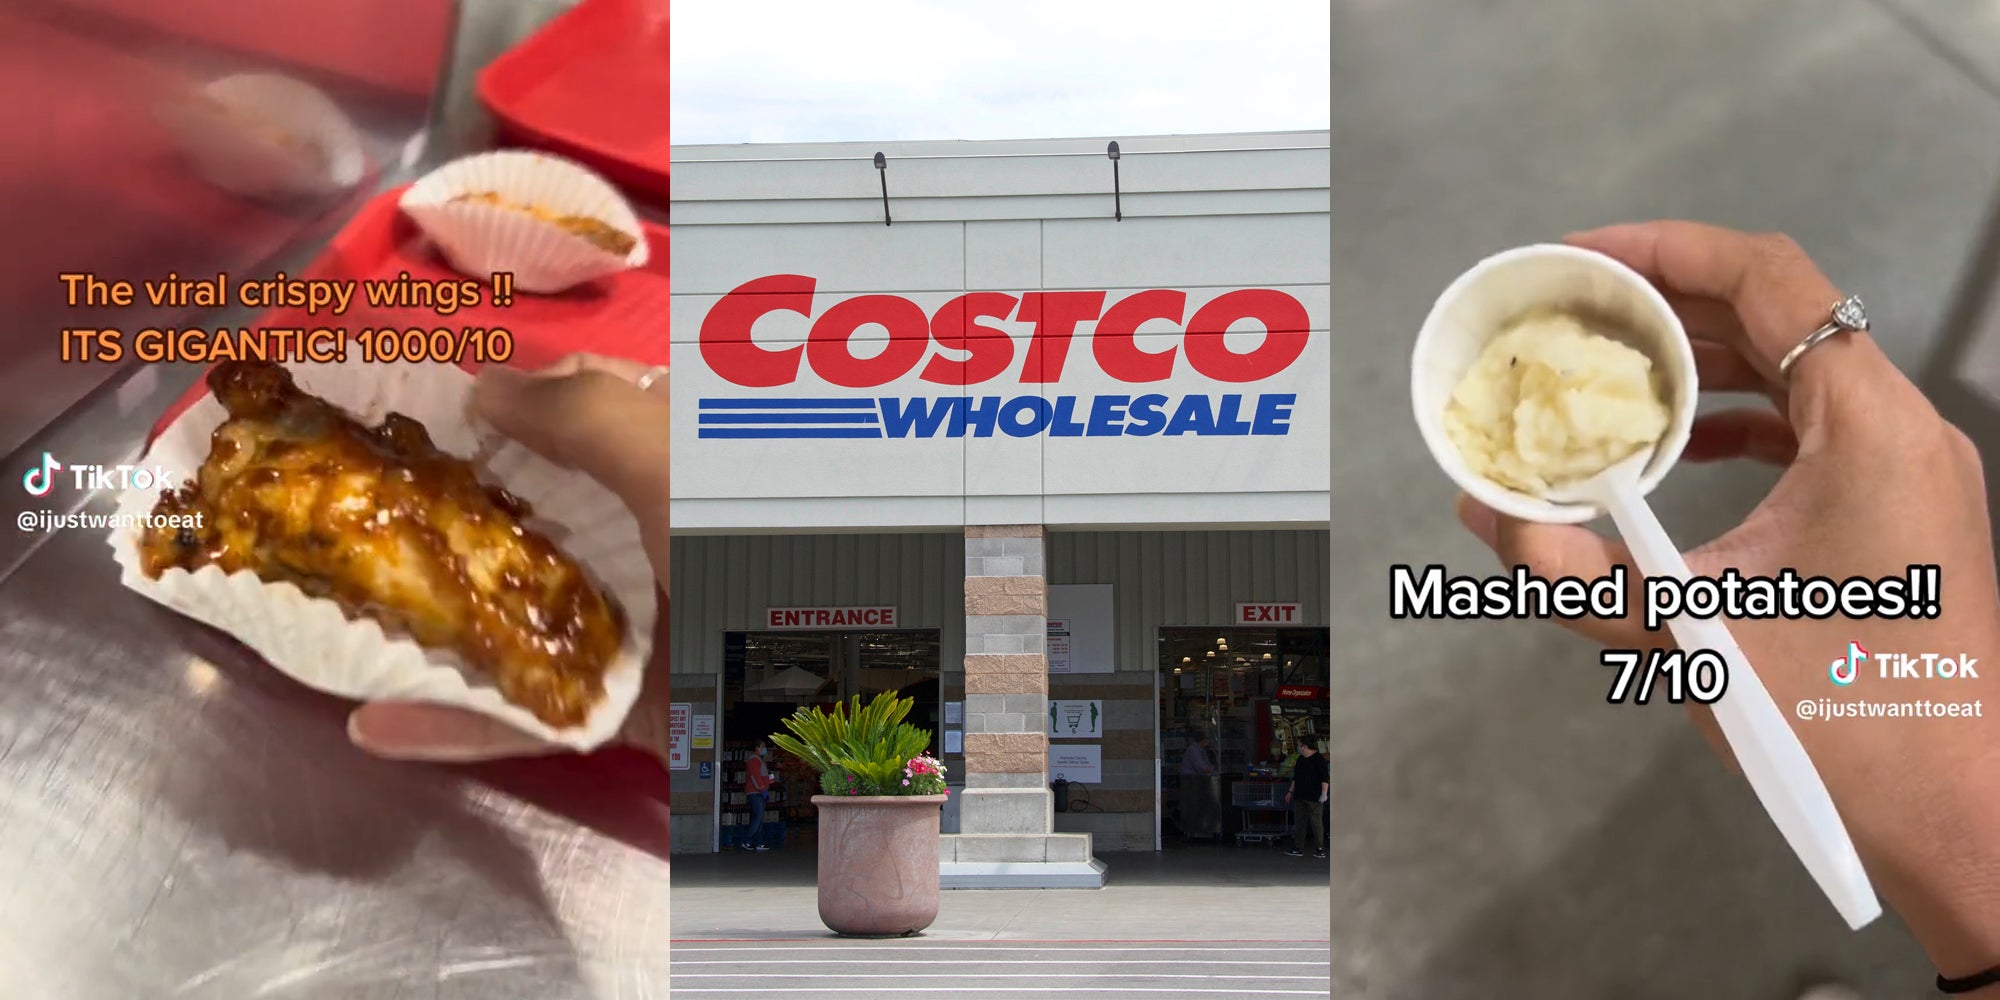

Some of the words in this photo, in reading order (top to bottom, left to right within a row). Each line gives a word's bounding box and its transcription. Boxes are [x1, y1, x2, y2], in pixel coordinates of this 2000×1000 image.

[699, 274, 1311, 388] COSTCO
[877, 393, 1297, 439] WHOLESALE
[770, 608, 894, 626] ENTRANCE
[1242, 605, 1296, 622] EXIT
